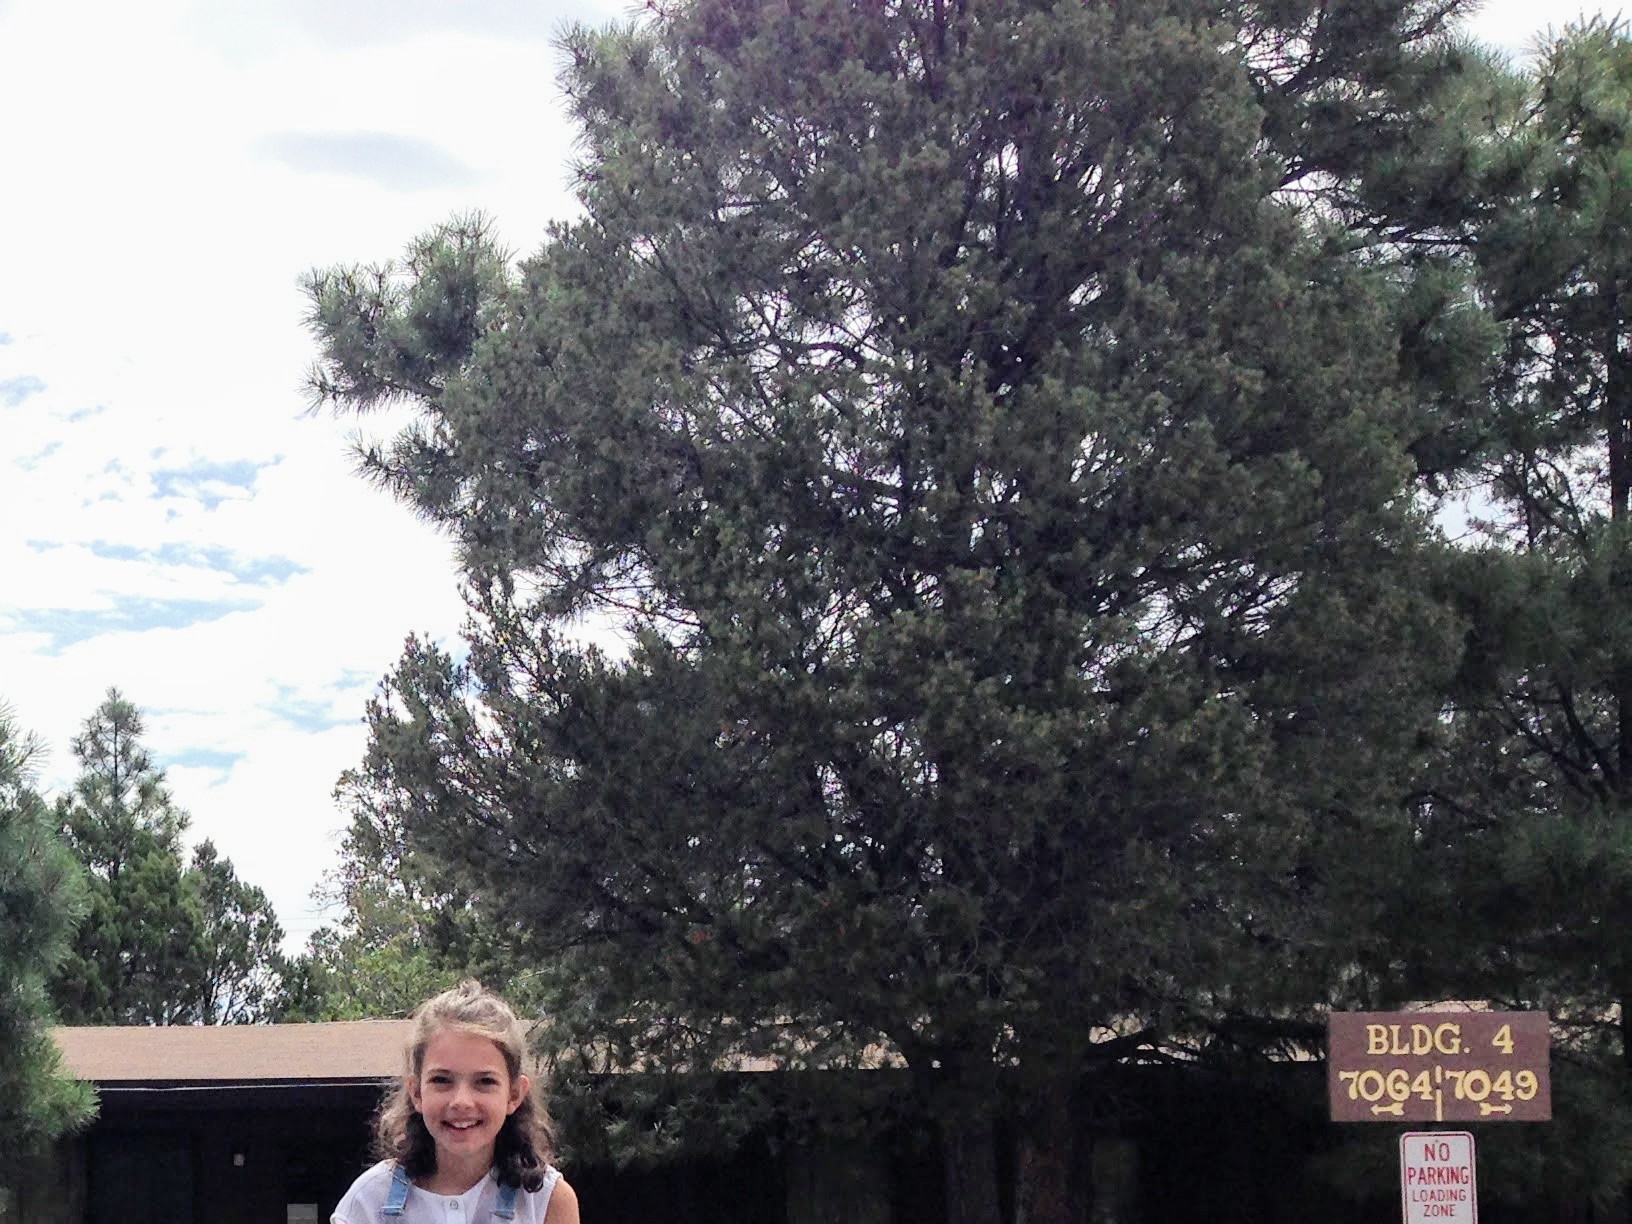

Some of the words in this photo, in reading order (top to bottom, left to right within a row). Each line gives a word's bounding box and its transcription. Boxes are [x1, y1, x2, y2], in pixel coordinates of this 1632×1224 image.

[1366, 1023, 1472, 1055] BLDG.
[1491, 1024, 1515, 1054] 4
[1338, 1069, 1434, 1102] 7064
[1445, 1069, 1539, 1101] 7049
[1424, 1143, 1451, 1162] NO
[1407, 1166, 1469, 1185] PARKING
[1412, 1188, 1467, 1203] LOADING
[1423, 1204, 1456, 1218] ZONE
